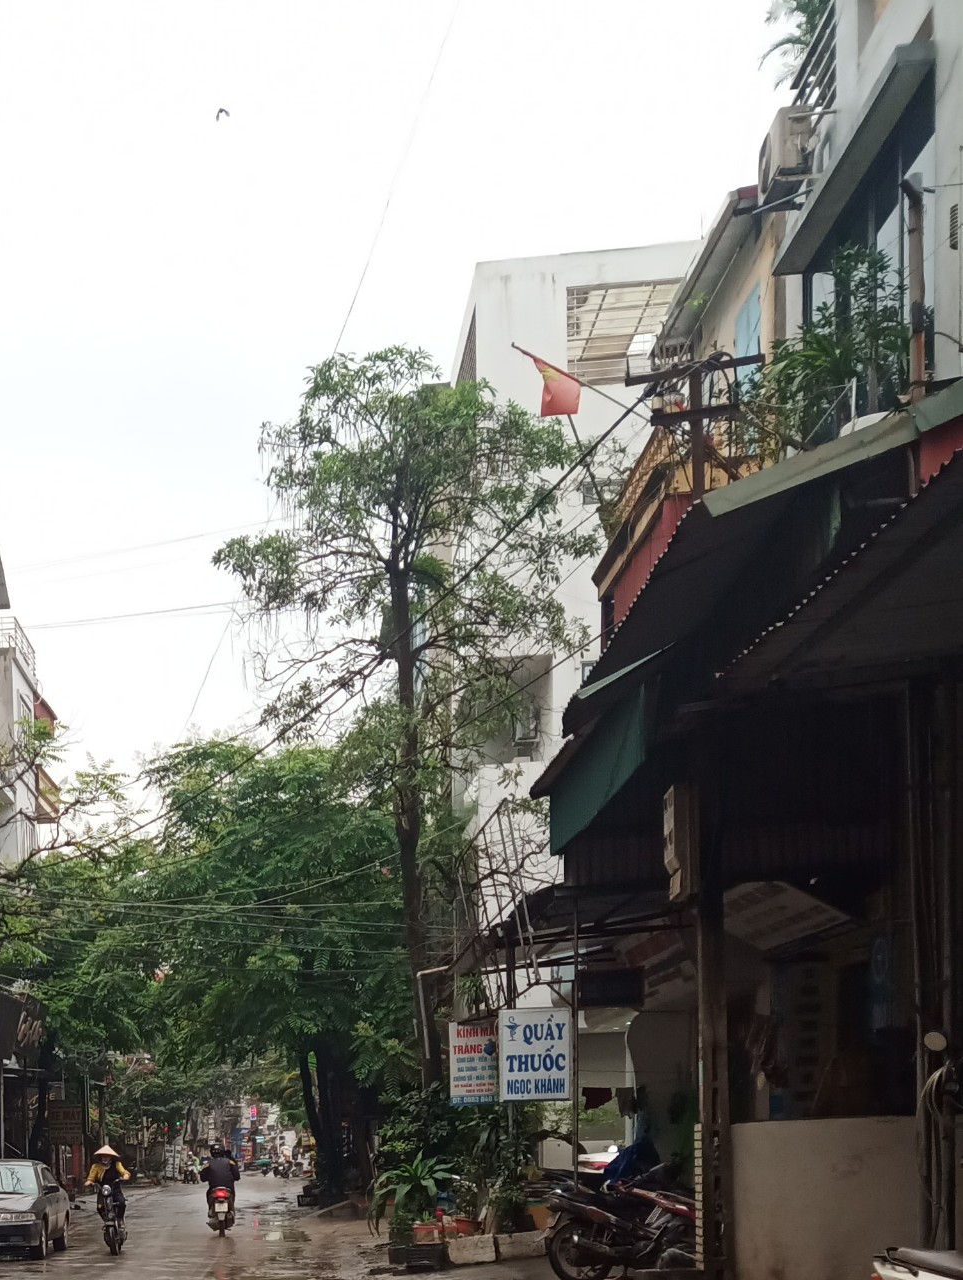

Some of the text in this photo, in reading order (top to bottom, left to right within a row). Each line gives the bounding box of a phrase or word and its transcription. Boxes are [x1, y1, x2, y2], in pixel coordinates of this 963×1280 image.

[523, 1014, 566, 1045] QUẦY
[506, 1045, 566, 1072] THUỐC
[507, 1079, 531, 1098] NGỌC
[535, 1075, 565, 1094] KHÁNH
